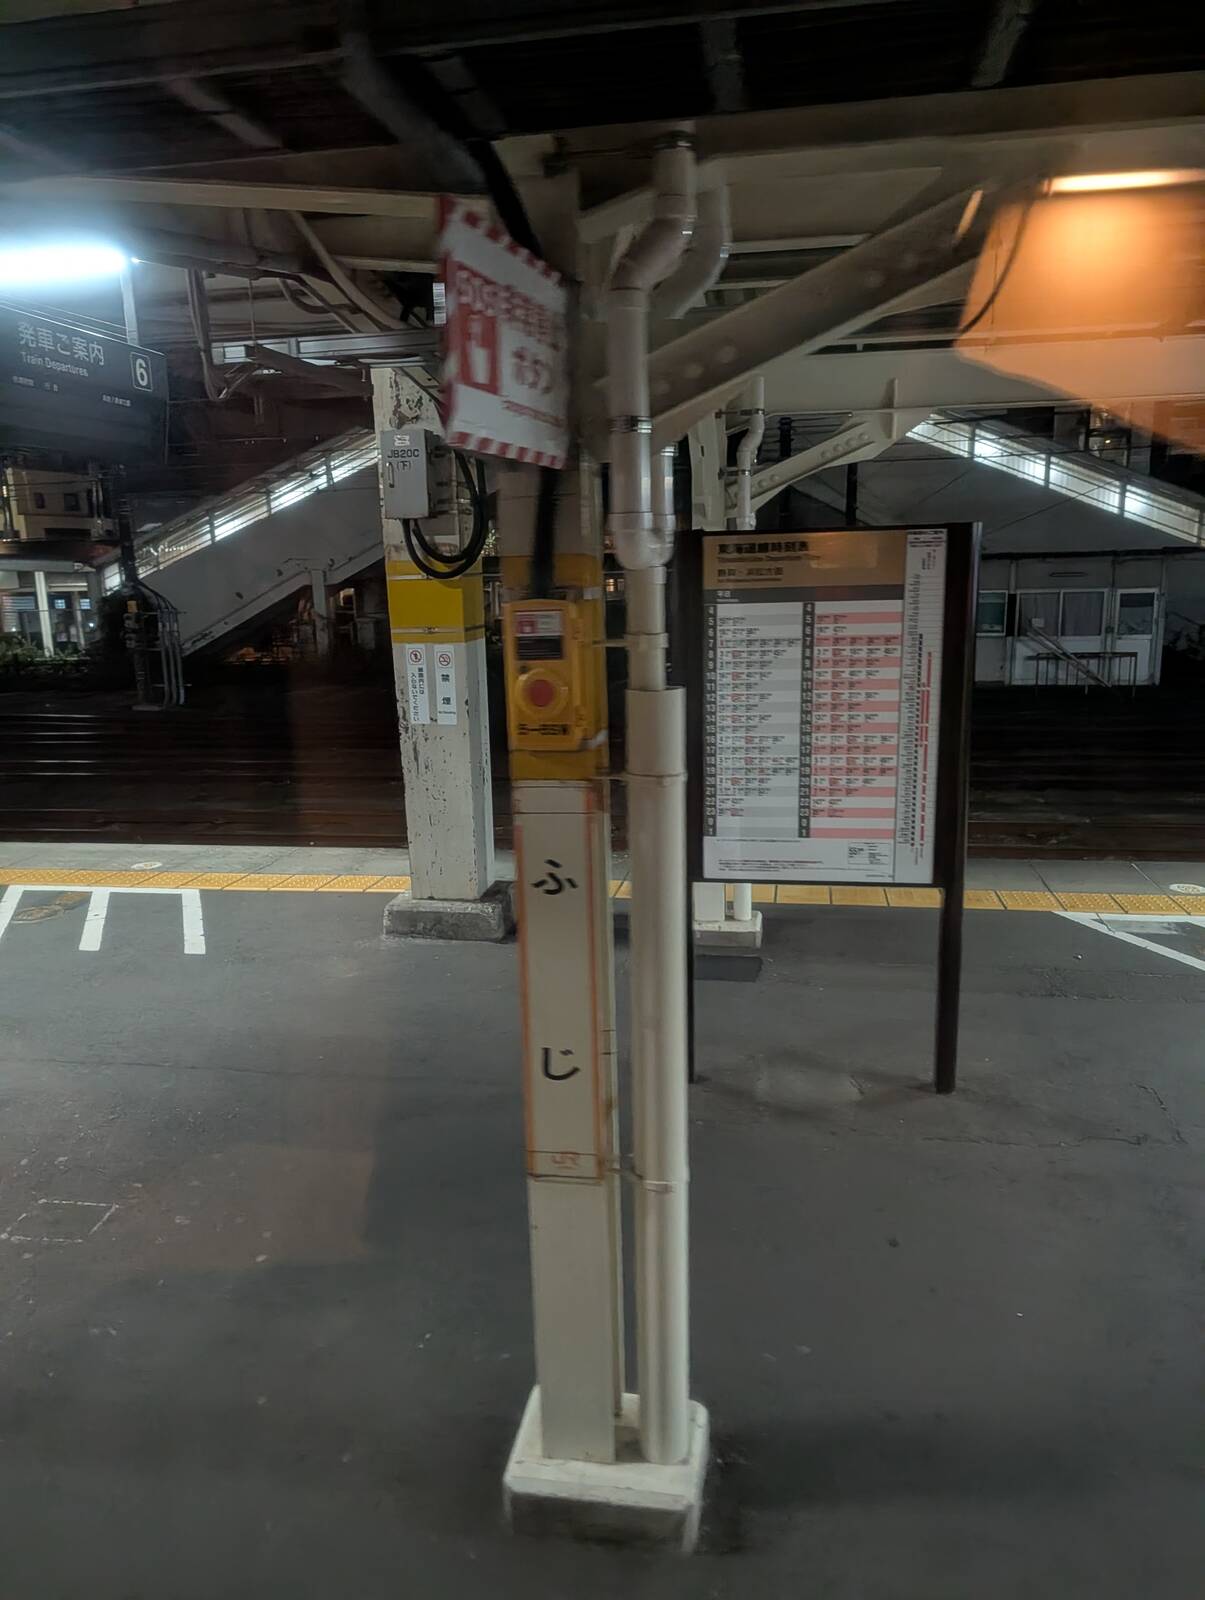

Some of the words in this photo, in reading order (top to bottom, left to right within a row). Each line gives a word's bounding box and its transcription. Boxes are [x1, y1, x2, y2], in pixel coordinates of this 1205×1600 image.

[18, 321, 104, 366] 発車ご案内
[21, 352, 43, 366] Train
[44, 357, 89, 377] Departures
[135, 358, 148, 386] 6
[387, 449, 420, 459] JB20C
[531, 858, 581, 1082] ふじ
